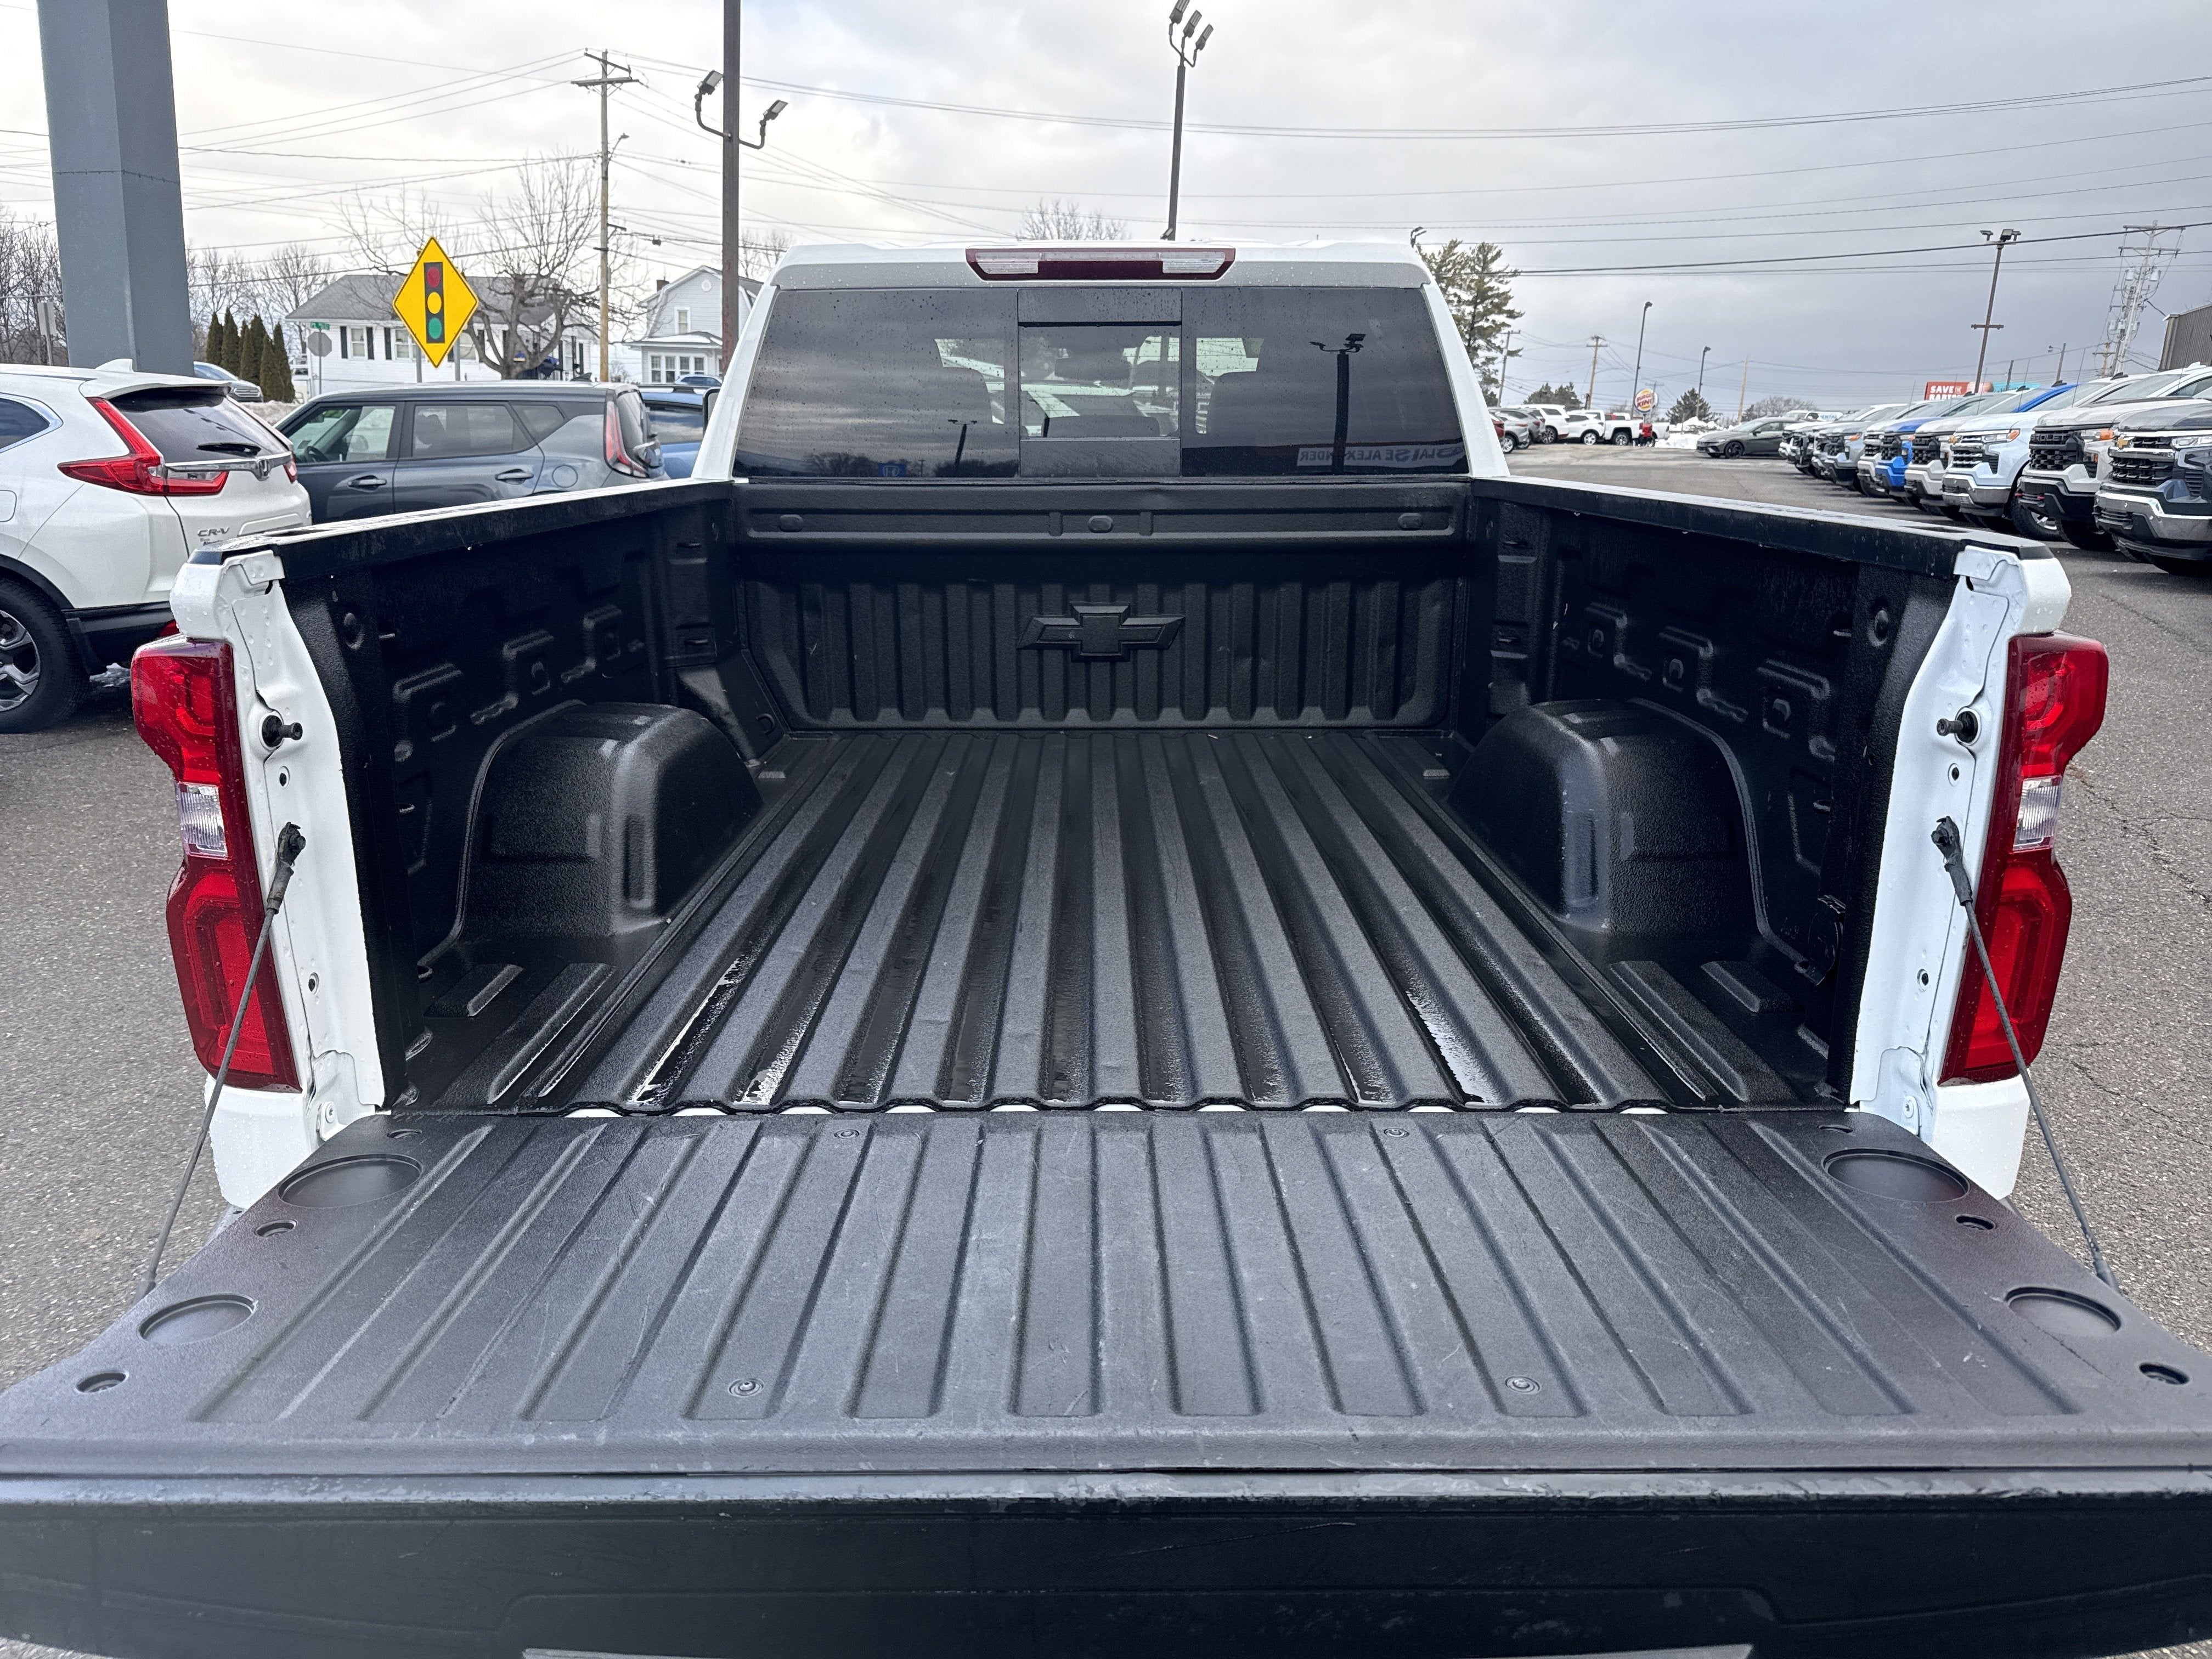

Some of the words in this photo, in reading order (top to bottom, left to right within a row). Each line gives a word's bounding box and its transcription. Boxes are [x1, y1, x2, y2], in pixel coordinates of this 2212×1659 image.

[1637, 393, 1654, 402] BURGE
[1637, 399, 1655, 408] KING
[198, 527, 230, 537] CR-V
